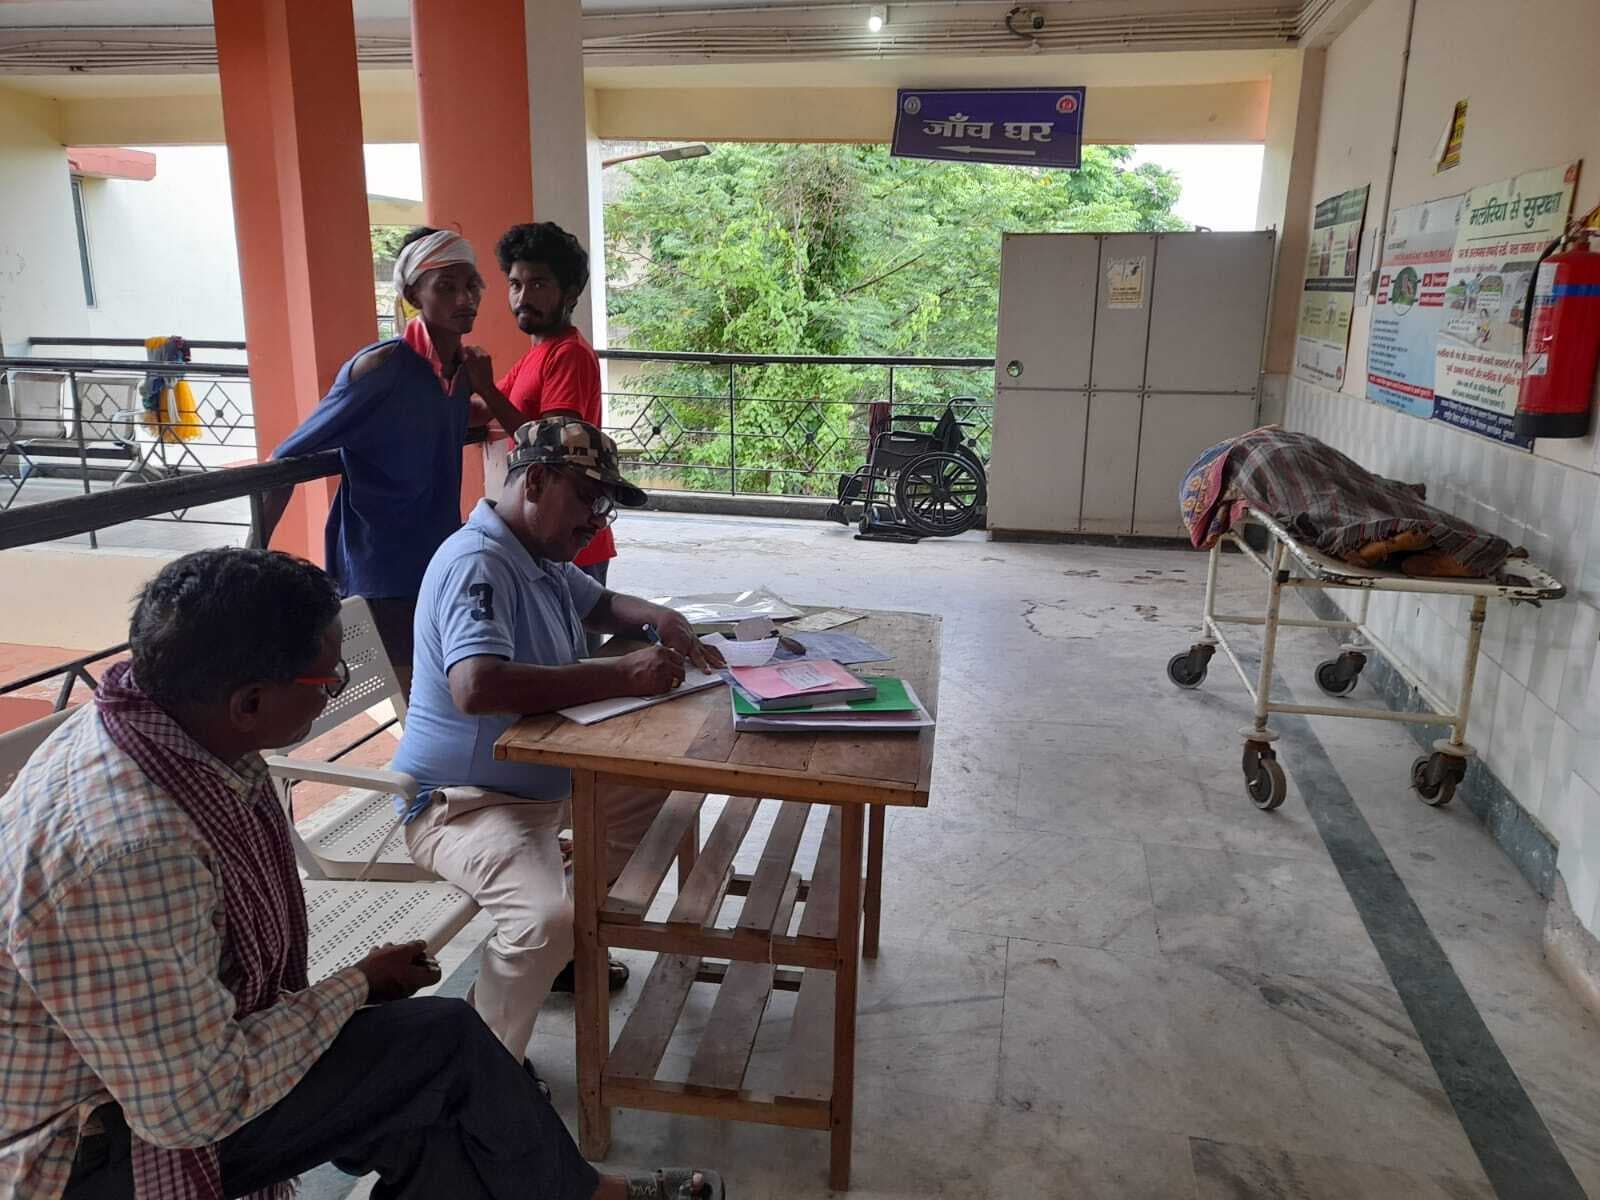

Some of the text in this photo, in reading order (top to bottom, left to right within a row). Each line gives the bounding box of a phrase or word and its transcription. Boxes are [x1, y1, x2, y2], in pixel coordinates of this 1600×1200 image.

[922, 112, 1055, 142] जाँच घर
[1510, 192, 1521, 220] से
[1522, 191, 1564, 228] सुरक्षा
[469, 583, 494, 621] 3
